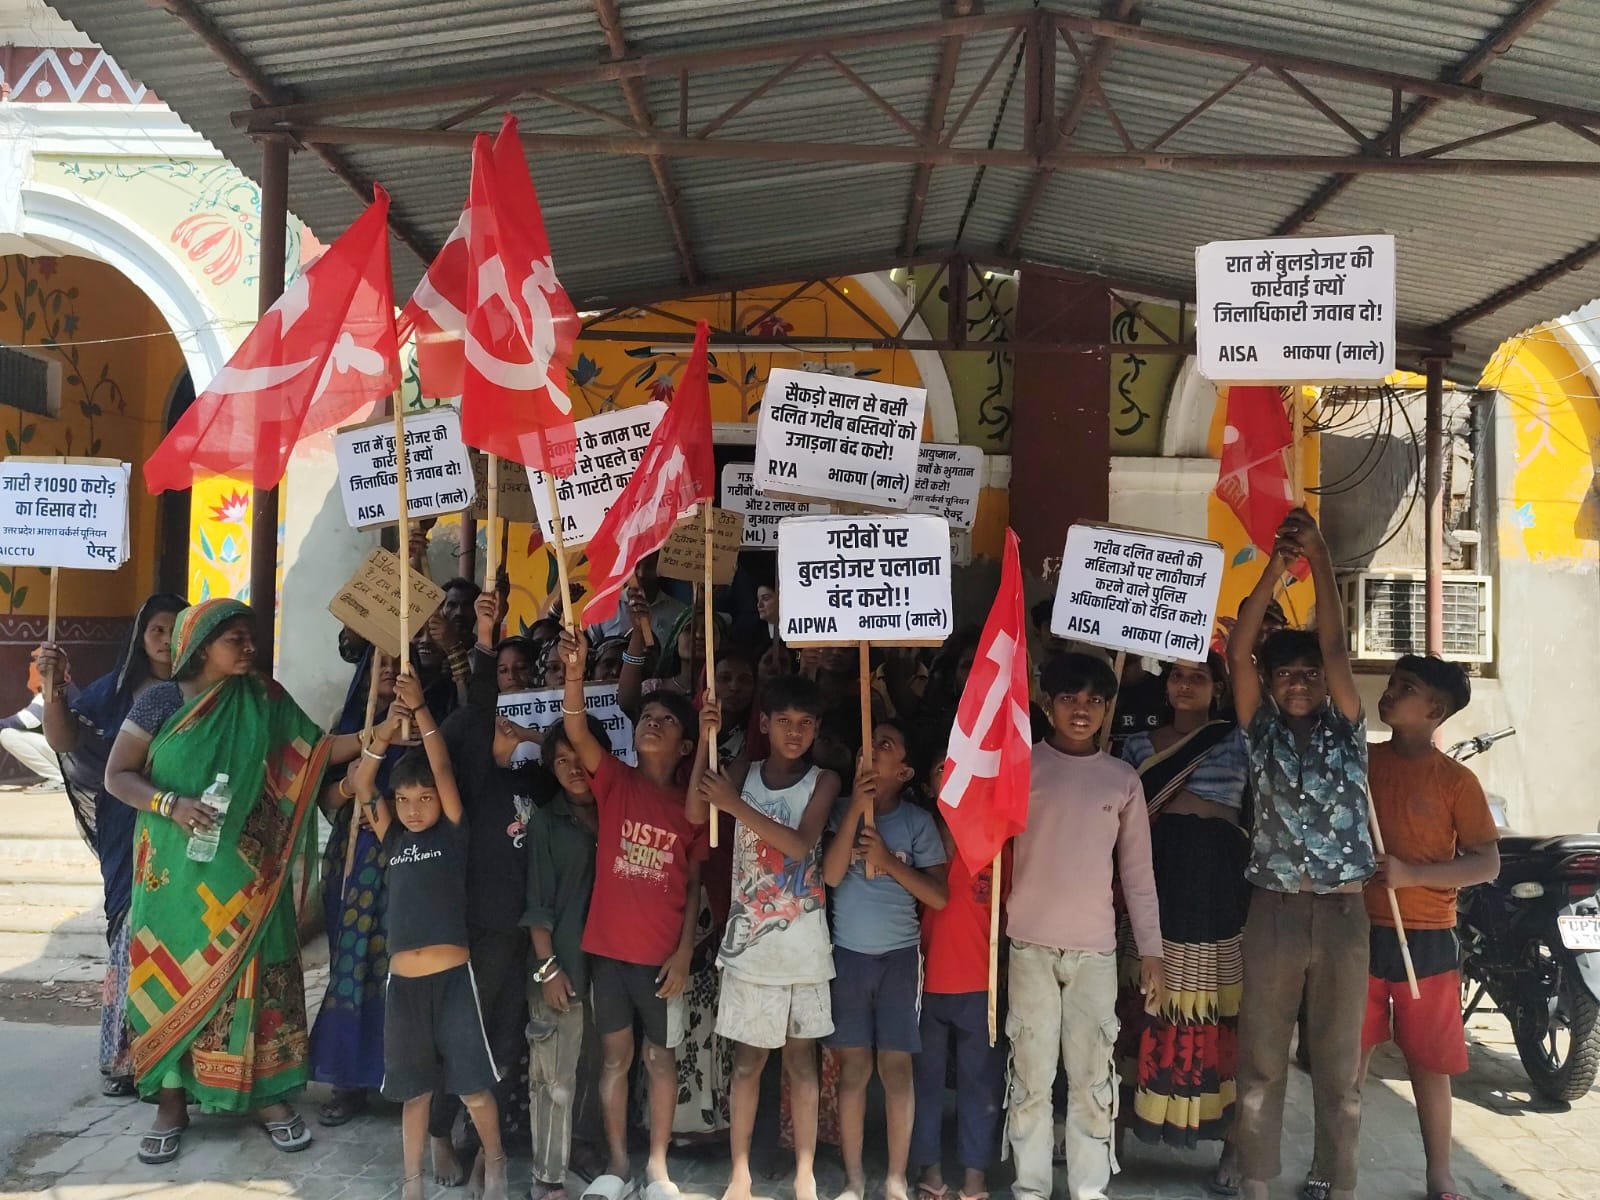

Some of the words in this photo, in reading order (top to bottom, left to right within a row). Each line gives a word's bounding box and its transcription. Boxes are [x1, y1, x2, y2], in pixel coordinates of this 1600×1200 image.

[1225, 255, 1252, 273] रात
[1256, 250, 1274, 272] में
[1275, 249, 1347, 277] बुलडोजर
[1350, 246, 1374, 268] की
[1251, 273, 1310, 297] कार्रवाई
[1313, 274, 1347, 296] क्यों
[1213, 301, 1308, 323] जिलाधिकारी
[1311, 304, 1356, 321] जवाब
[1359, 299, 1383, 322] दो!
[1218, 345, 1258, 362] AISA
[1283, 345, 1332, 361] भाकपा
[1335, 340, 1385, 364] (माले)
[785, 382, 827, 408] सैकड़ो
[828, 392, 861, 411] साल
[862, 393, 877, 413] से
[879, 397, 908, 417] बसी
[771, 404, 809, 426] दलित
[810, 410, 845, 431] गरीब
[846, 415, 898, 438] बस्तियों
[897, 421, 918, 441] को
[352, 440, 371, 455] रात
[371, 435, 384, 450] में
[385, 430, 431, 453] बुडोजर
[432, 425, 448, 441] की
[584, 431, 598, 450] के
[599, 426, 630, 446] नाम
[631, 422, 652, 439] पर
[785, 431, 838, 454] उजाड़ना
[839, 436, 860, 456] बंद
[861, 441, 894, 461] करो!
[372, 449, 411, 469] कार्रवई
[413, 445, 434, 463] क्यों
[578, 455, 594, 474] से
[595, 447, 627, 470] पहले
[918, 447, 957, 462] आयुष्मान
[350, 468, 413, 491] जिलाधिकरी
[414, 466, 443, 480] जवाब
[445, 460, 462, 476] दो!
[768, 459, 798, 479] RYA
[828, 468, 868, 486] भाकपा
[871, 470, 910, 494] (माले)
[933, 464, 942, 476] के
[943, 466, 975, 478] भुगतान
[2, 472, 31, 492] जारी
[35, 477, 78, 493] ₹1090
[81, 475, 117, 498] करोड़
[556, 480, 575, 501] की
[576, 473, 613, 497] गारंटी
[727, 484, 755, 496] गरीबों
[915, 478, 929, 490] रंटी
[930, 479, 951, 491] करो!
[15, 501, 33, 516] का
[35, 497, 76, 518] हिसाब
[78, 499, 97, 518] दो!
[406, 493, 433, 510] ाकपा
[436, 488, 468, 508] (माले)
[745, 498, 762, 511] और
[764, 501, 771, 511] 2
[772, 501, 796, 512] लाख
[797, 503, 810, 512] का
[945, 495, 970, 506] यूनियन
[358, 504, 385, 520] AISA
[747, 514, 781, 528] मुआवज
[943, 507, 963, 521] ऐक्टू
[18, 524, 35, 536] प्रदेश
[37, 527, 57, 536] आशा
[59, 526, 79, 536] वर्कर्स
[80, 526, 108, 540] यूनियन
[740, 527, 767, 544] (ML)
[826, 523, 882, 549] गरीबों
[882, 528, 909, 547] पर
[86, 540, 117, 563] ऐक्टू
[1093, 539, 1122, 555] गरीब
[1122, 543, 1153, 562] दलित
[1156, 549, 1185, 567] बस्ती
[1186, 552, 1204, 569] की
[797, 553, 876, 587] बुलडोजर
[878, 556, 942, 577] चलाना
[1085, 557, 1136, 576] महिलाओं
[1137, 565, 1154, 580] पर
[1155, 569, 1208, 588] लाठीचार्ज
[826, 584, 854, 608] बंद
[856, 582, 911, 607] करो!!
[1096, 577, 1126, 593] करने
[1126, 582, 1151, 598] वाले
[1152, 586, 1188, 605] पुलिस
[858, 614, 901, 629] भाकपा
[905, 608, 948, 631] (माले)
[1070, 591, 1131, 613] अधिकारियों
[1131, 600, 1149, 617] को
[1149, 602, 1178, 622] दंडित
[1179, 610, 1208, 627] करो!
[787, 616, 838, 634] AIPWA
[1067, 616, 1101, 636] AISA
[1121, 625, 1163, 644] भाकपा
[1164, 630, 1205, 655] (माले)
[535, 697, 546, 715] के
